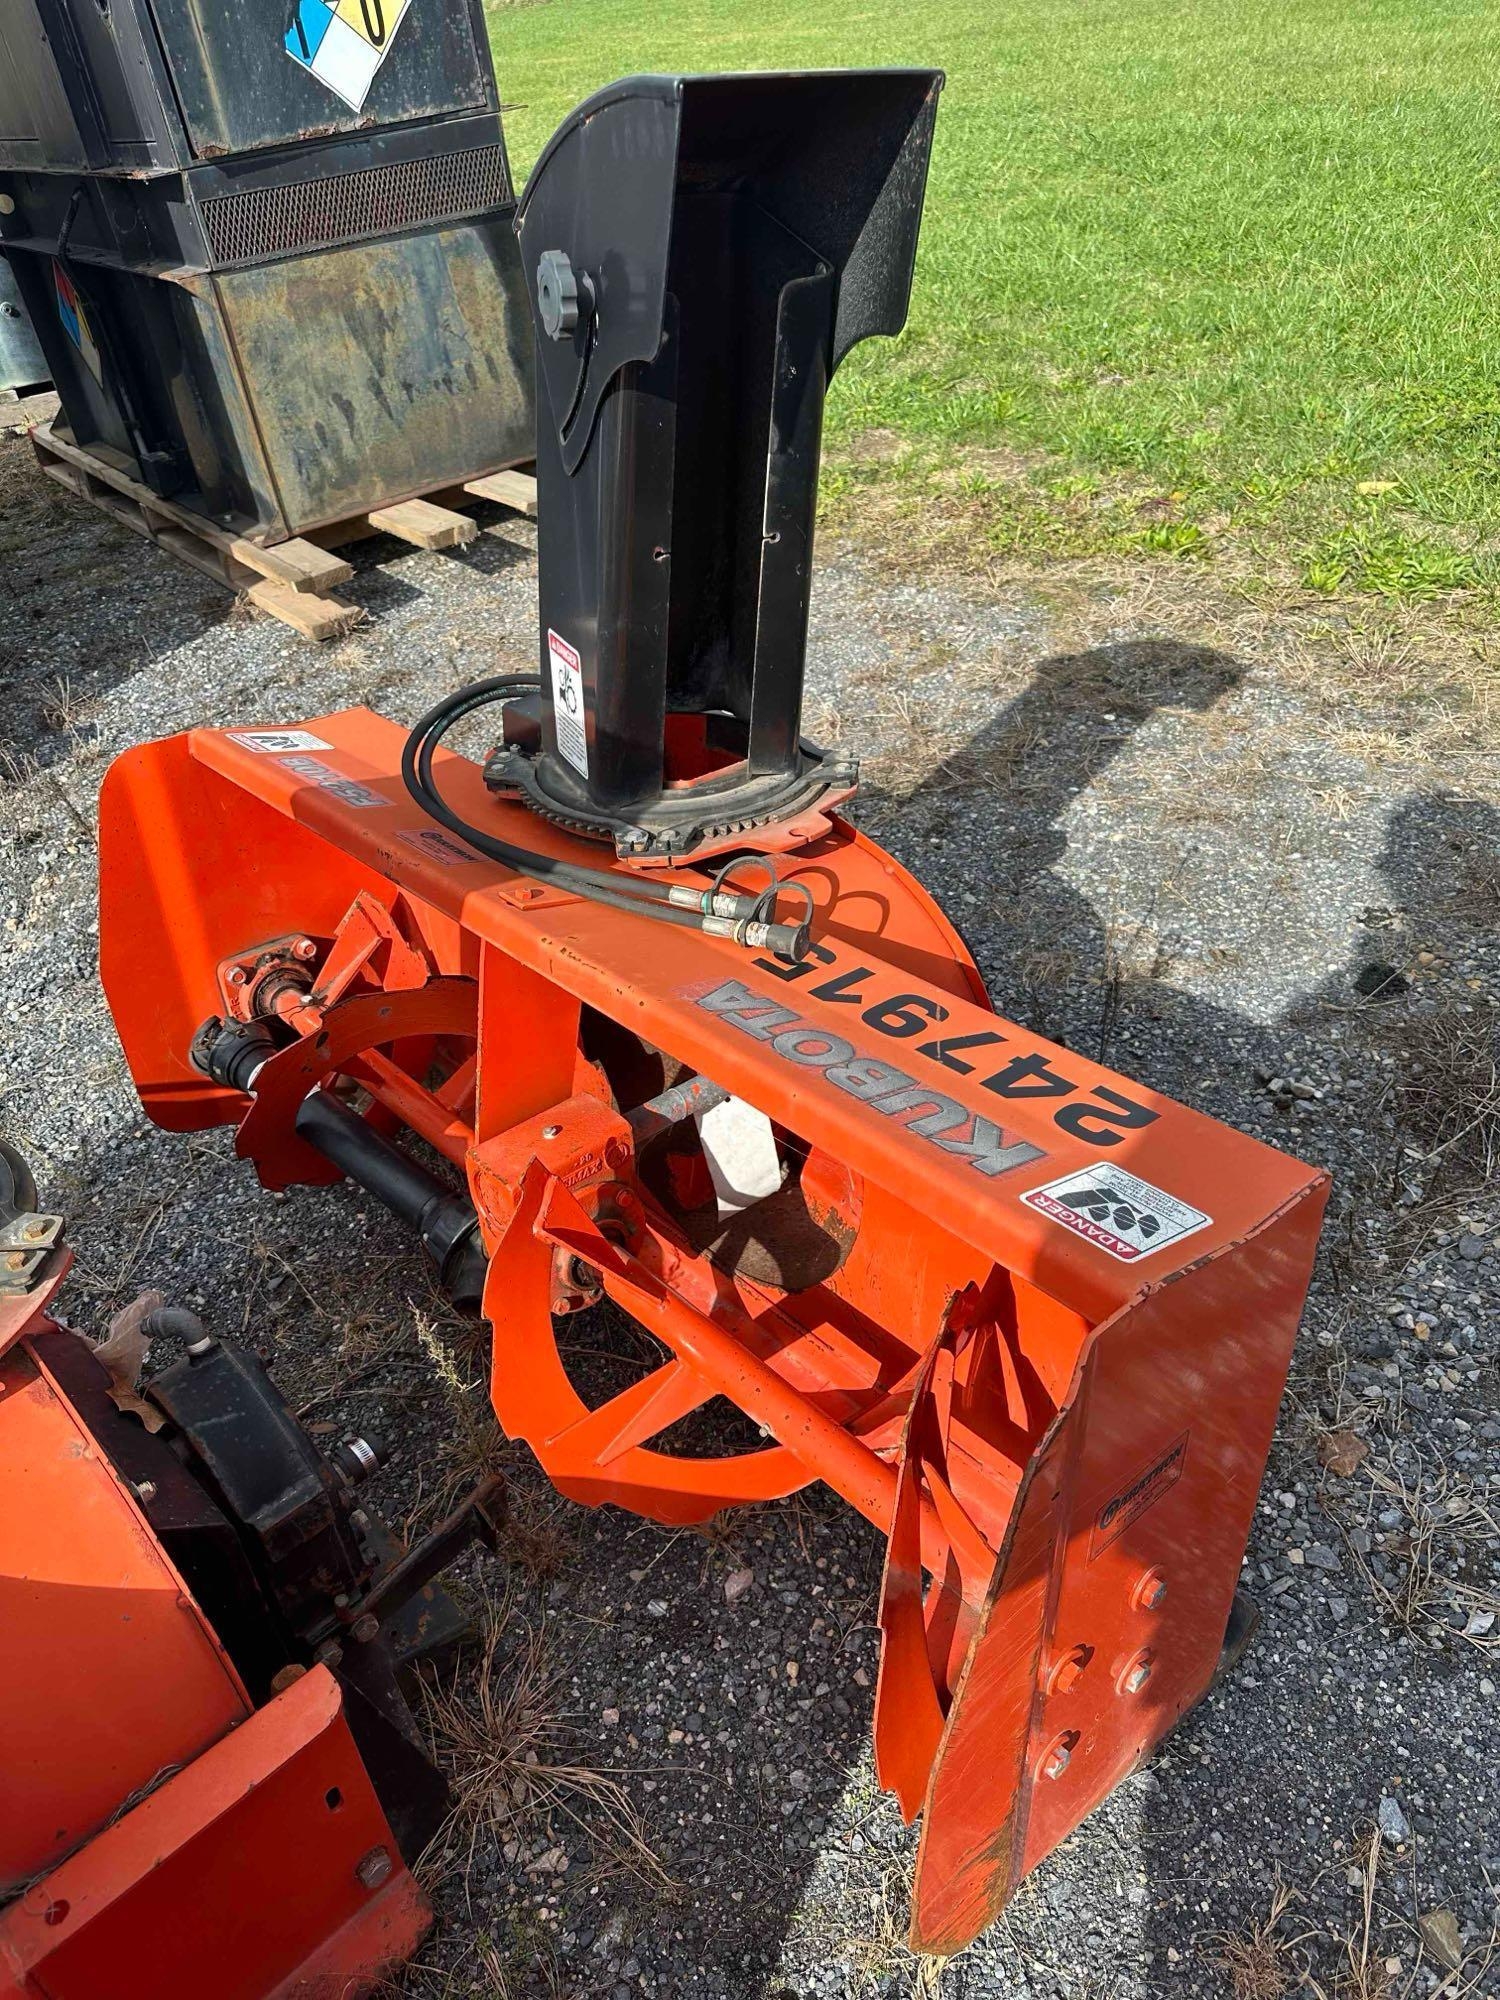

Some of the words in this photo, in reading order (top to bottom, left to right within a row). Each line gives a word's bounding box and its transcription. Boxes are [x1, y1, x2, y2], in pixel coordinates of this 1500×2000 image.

[697, 980, 1047, 1176] KUBOTA
[752, 941, 1162, 1146] 247915
[1032, 1195, 1118, 1246] DANGER
